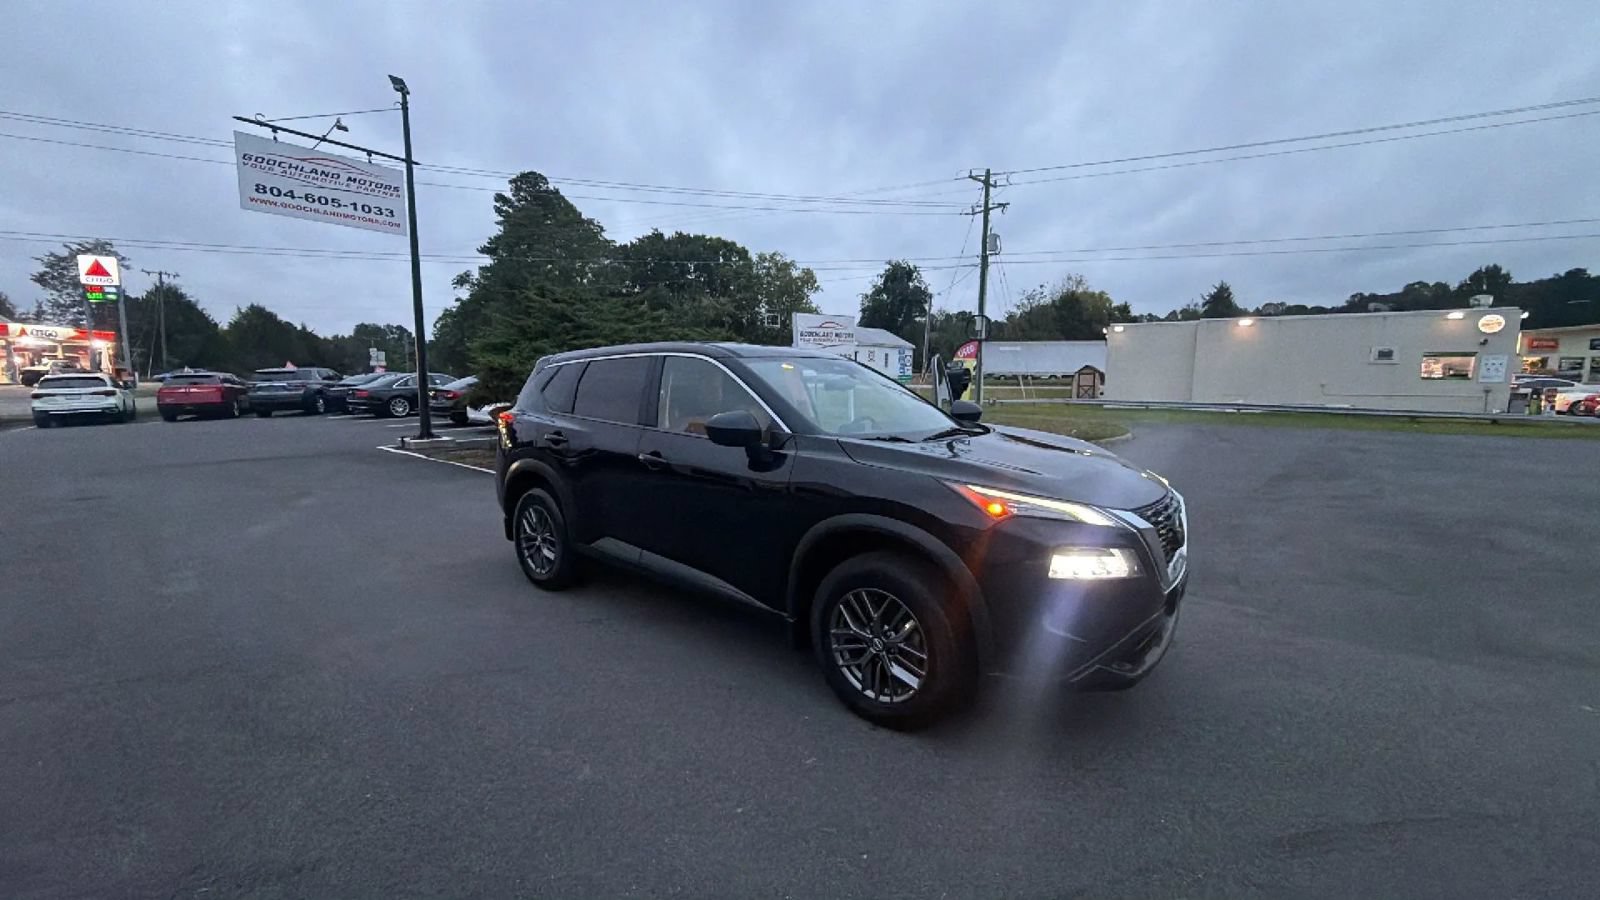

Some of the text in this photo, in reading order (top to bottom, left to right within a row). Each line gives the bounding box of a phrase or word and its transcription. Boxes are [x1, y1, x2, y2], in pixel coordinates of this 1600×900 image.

[242, 153, 400, 193] GOOCHLAND MOTORS
[242, 161, 275, 171] YOUR
[280, 169, 351, 188] AUTOMOTIVE
[254, 183, 396, 218] 804-605-1033
[958, 344, 976, 358] USED
